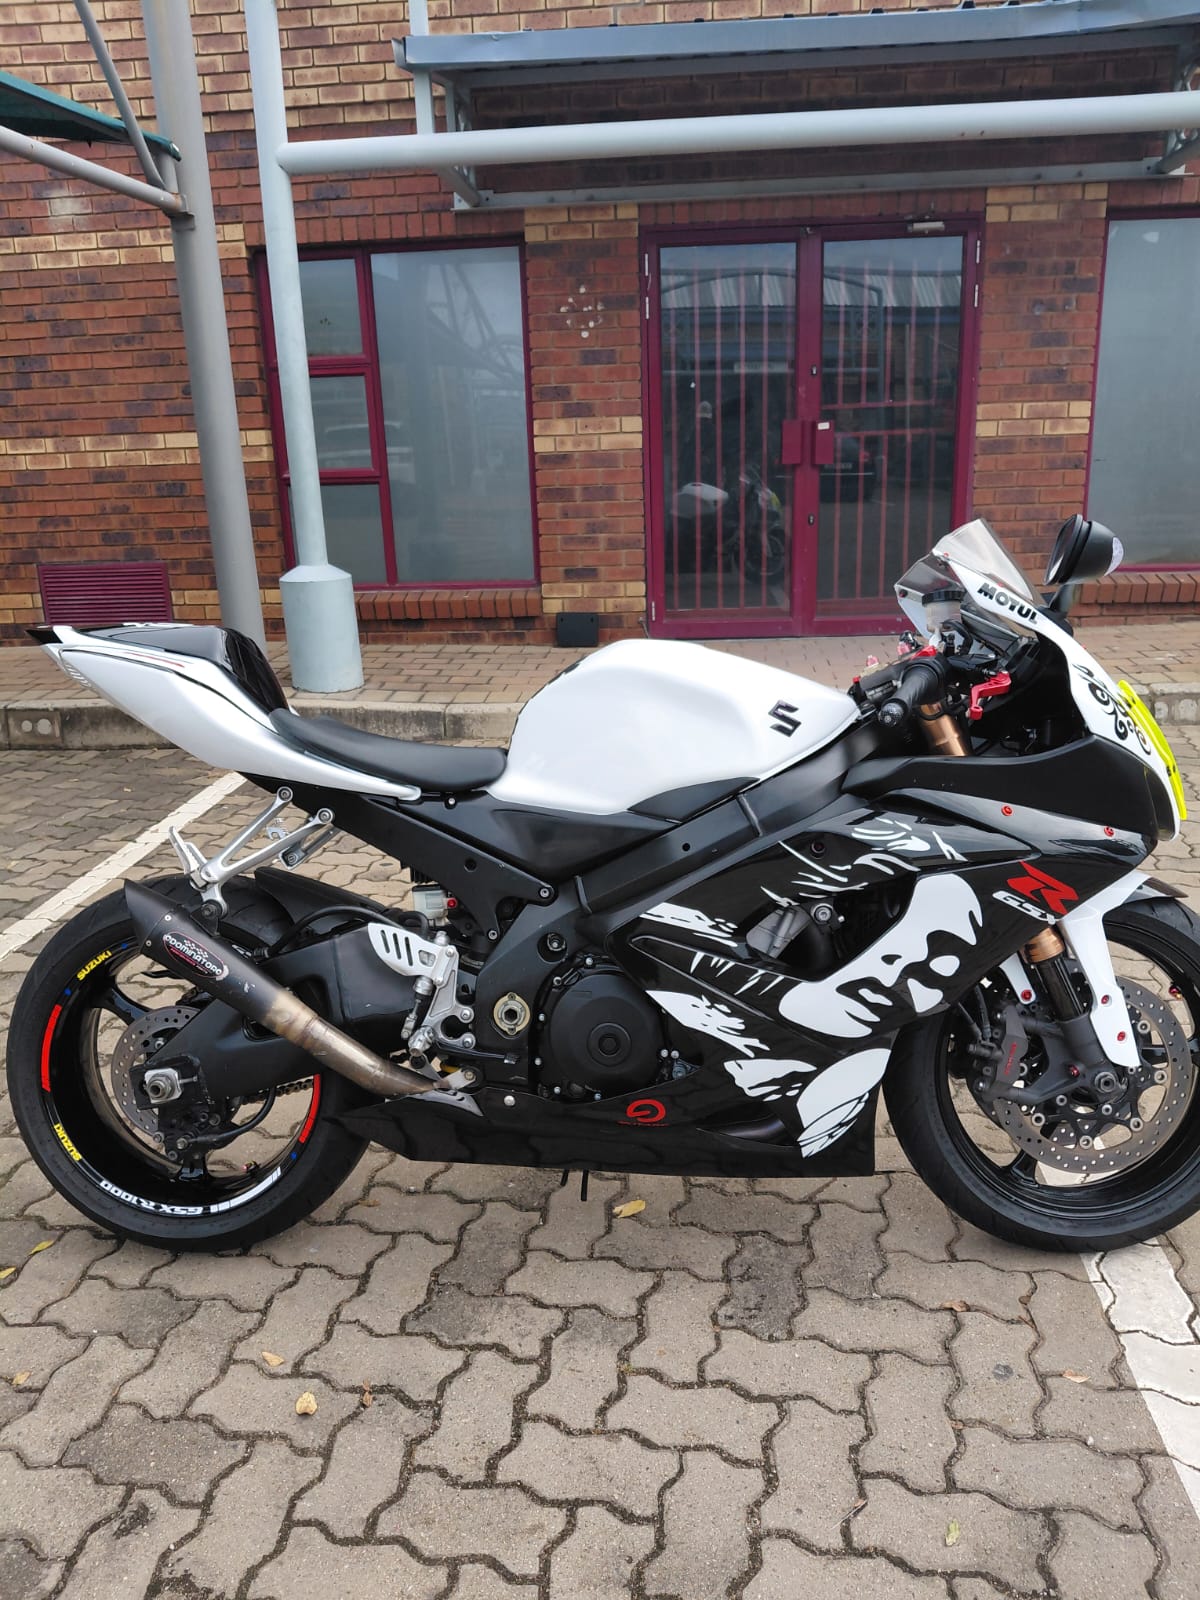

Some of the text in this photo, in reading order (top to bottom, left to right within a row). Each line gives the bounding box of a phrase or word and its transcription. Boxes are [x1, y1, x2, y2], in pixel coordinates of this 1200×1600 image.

[977, 583, 1038, 624] MOTUL
[76, 950, 112, 981] SUZUKI
[54, 1123, 82, 1161] SUZUKI
